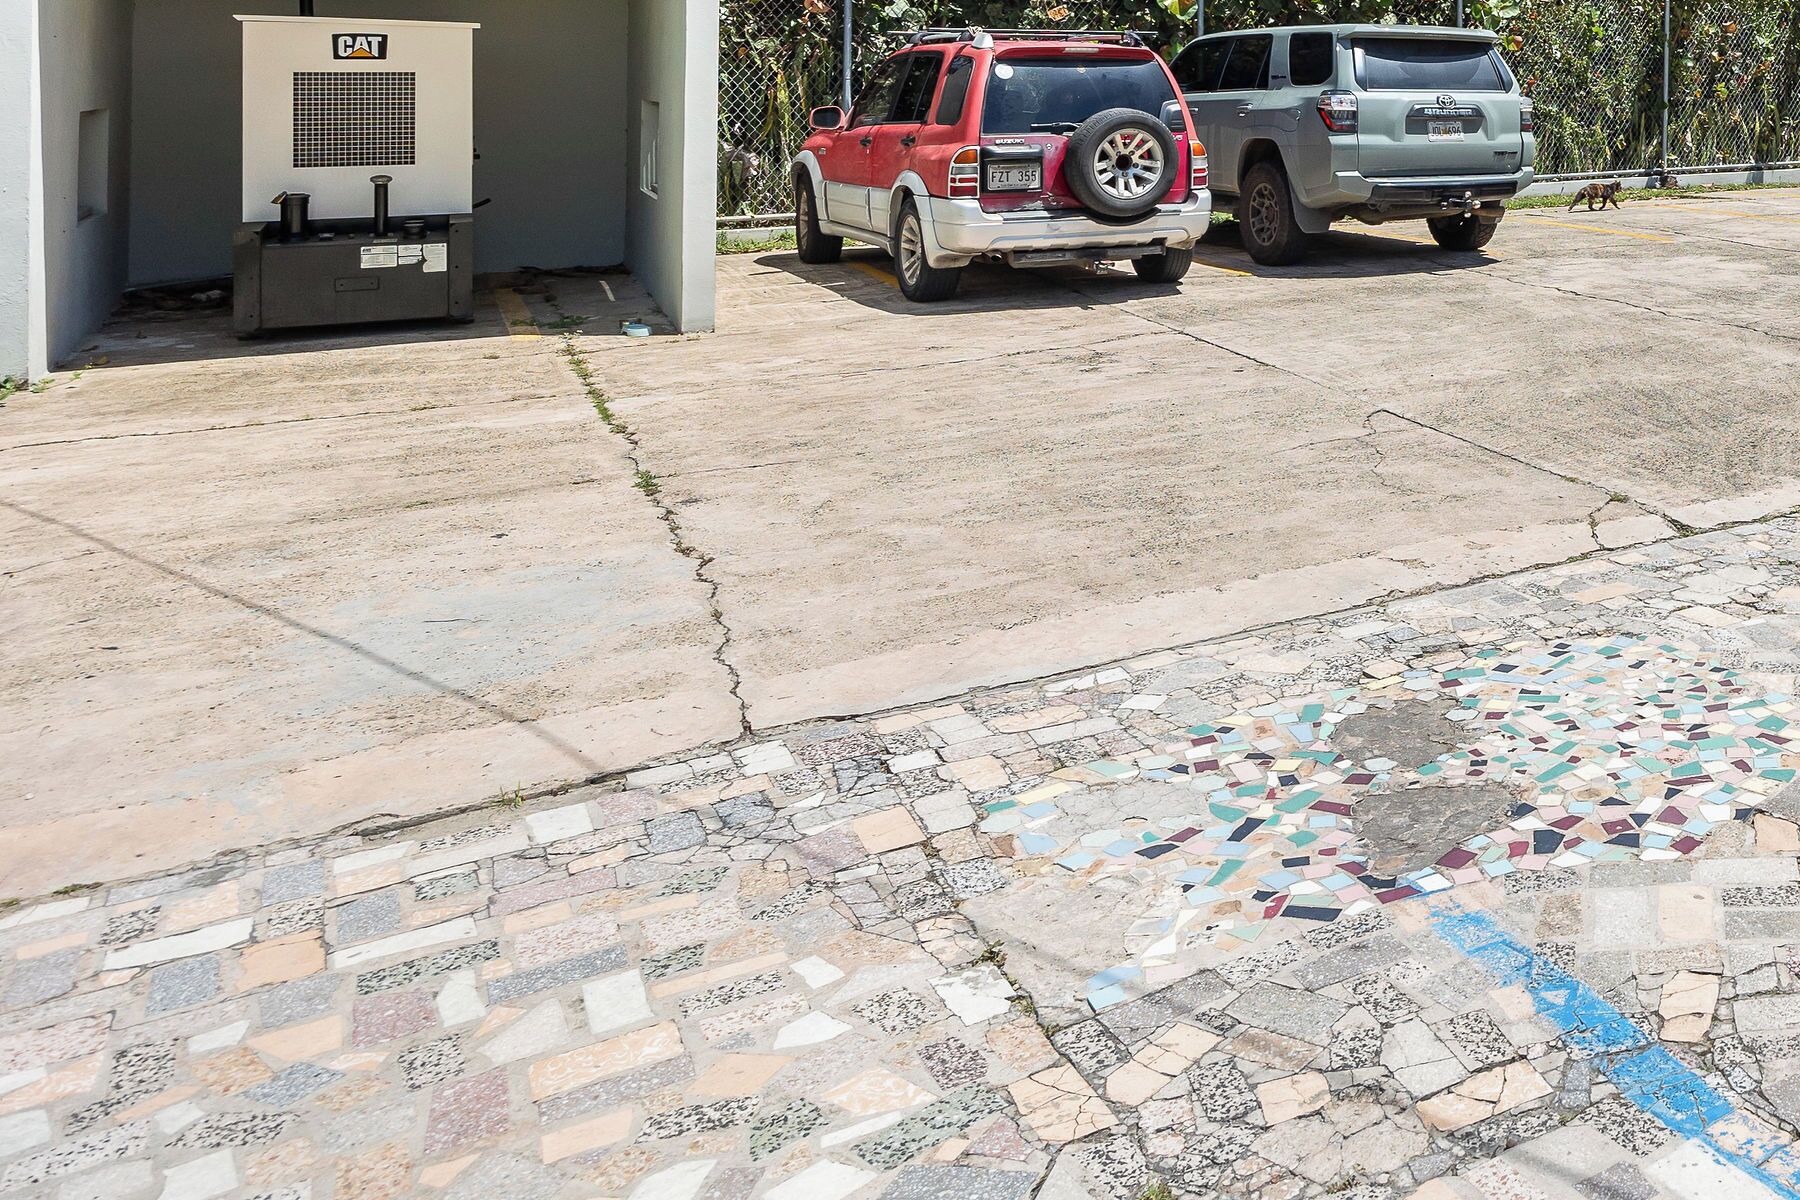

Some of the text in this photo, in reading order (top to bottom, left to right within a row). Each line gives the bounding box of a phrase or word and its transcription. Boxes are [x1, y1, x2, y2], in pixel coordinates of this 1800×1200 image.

[338, 36, 382, 57] CAT
[991, 170, 1037, 183] FZT 355
